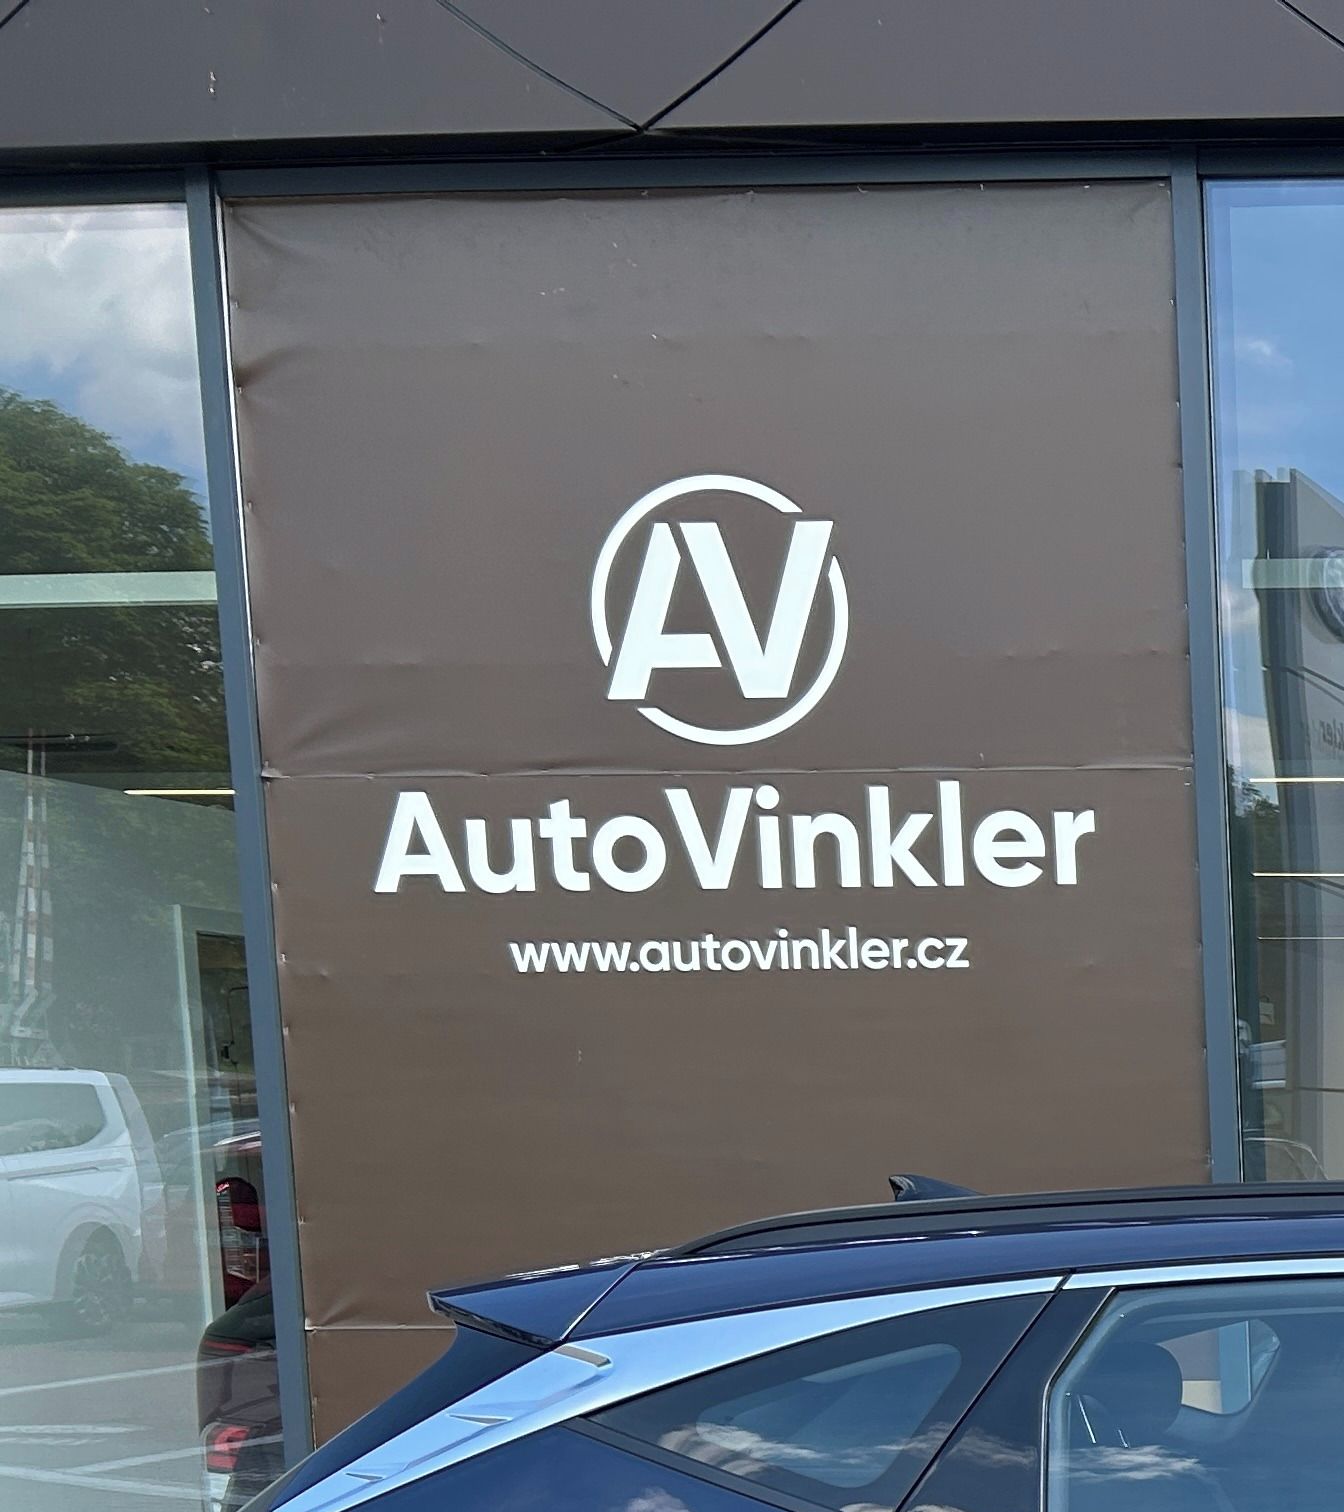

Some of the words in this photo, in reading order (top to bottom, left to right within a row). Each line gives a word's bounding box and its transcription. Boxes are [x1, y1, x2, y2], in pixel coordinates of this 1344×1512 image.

[607, 519, 834, 701] AV
[374, 780, 1096, 894] AutoVinkler
[509, 926, 970, 973] www.autovinkler.cz
